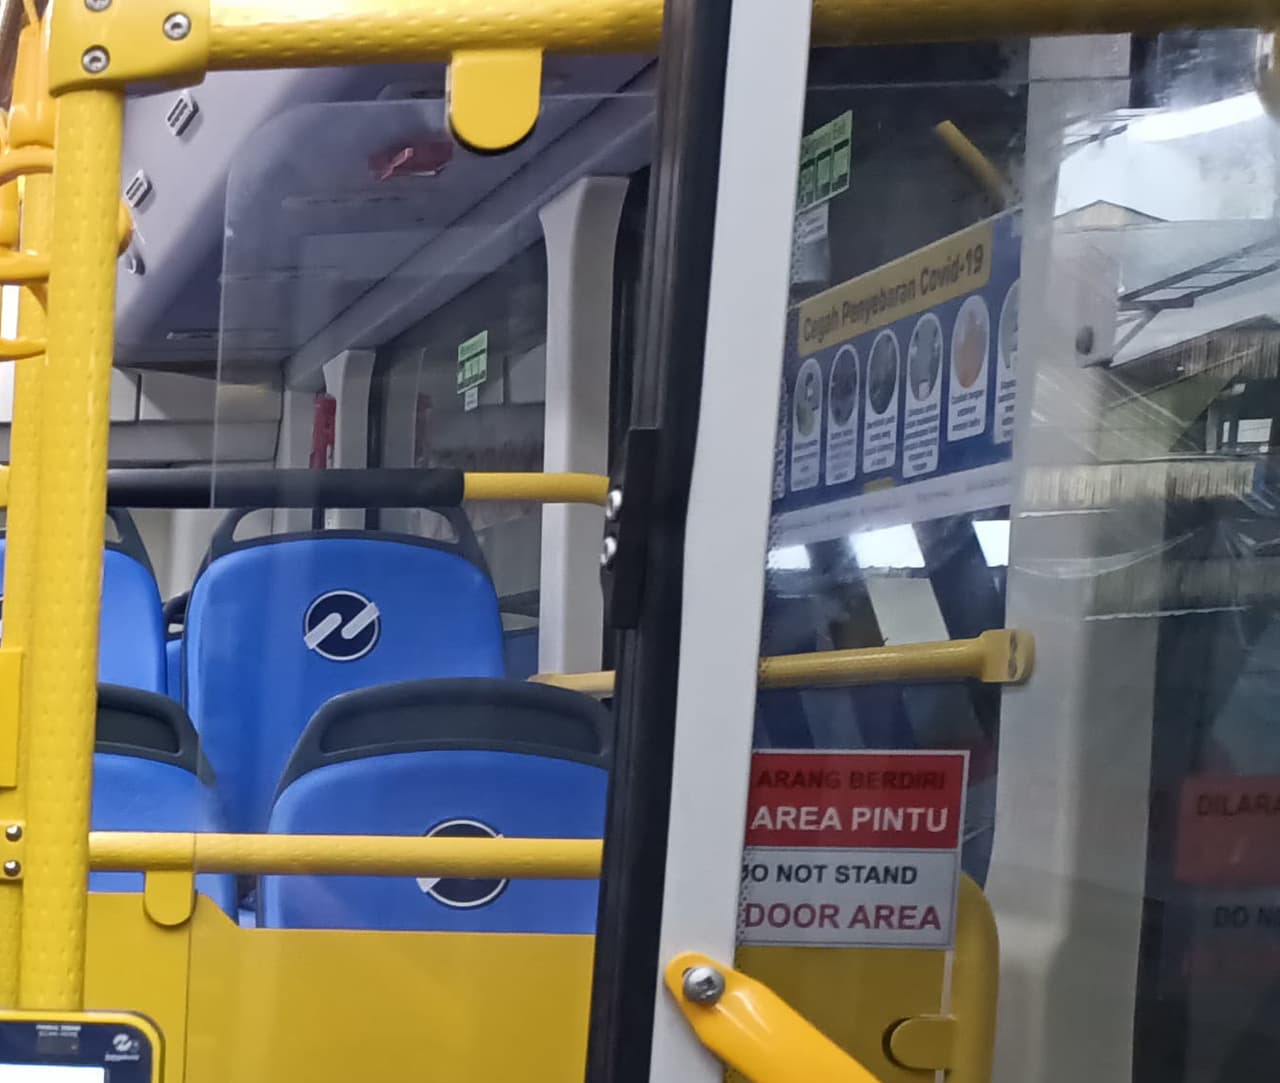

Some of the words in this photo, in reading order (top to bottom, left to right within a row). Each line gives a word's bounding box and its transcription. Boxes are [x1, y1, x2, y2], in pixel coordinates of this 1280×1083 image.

[841, 278, 916, 327] Penyebaran
[920, 243, 984, 295] Covid-19
[756, 769, 842, 790] ARANG
[850, 769, 945, 791] BERDIRI
[751, 806, 842, 831] AREA
[851, 807, 948, 833] PINTU
[776, 864, 827, 883] NOT
[835, 865, 917, 884] STAND
[745, 903, 840, 929] DOOR
[848, 904, 941, 930] AREA
